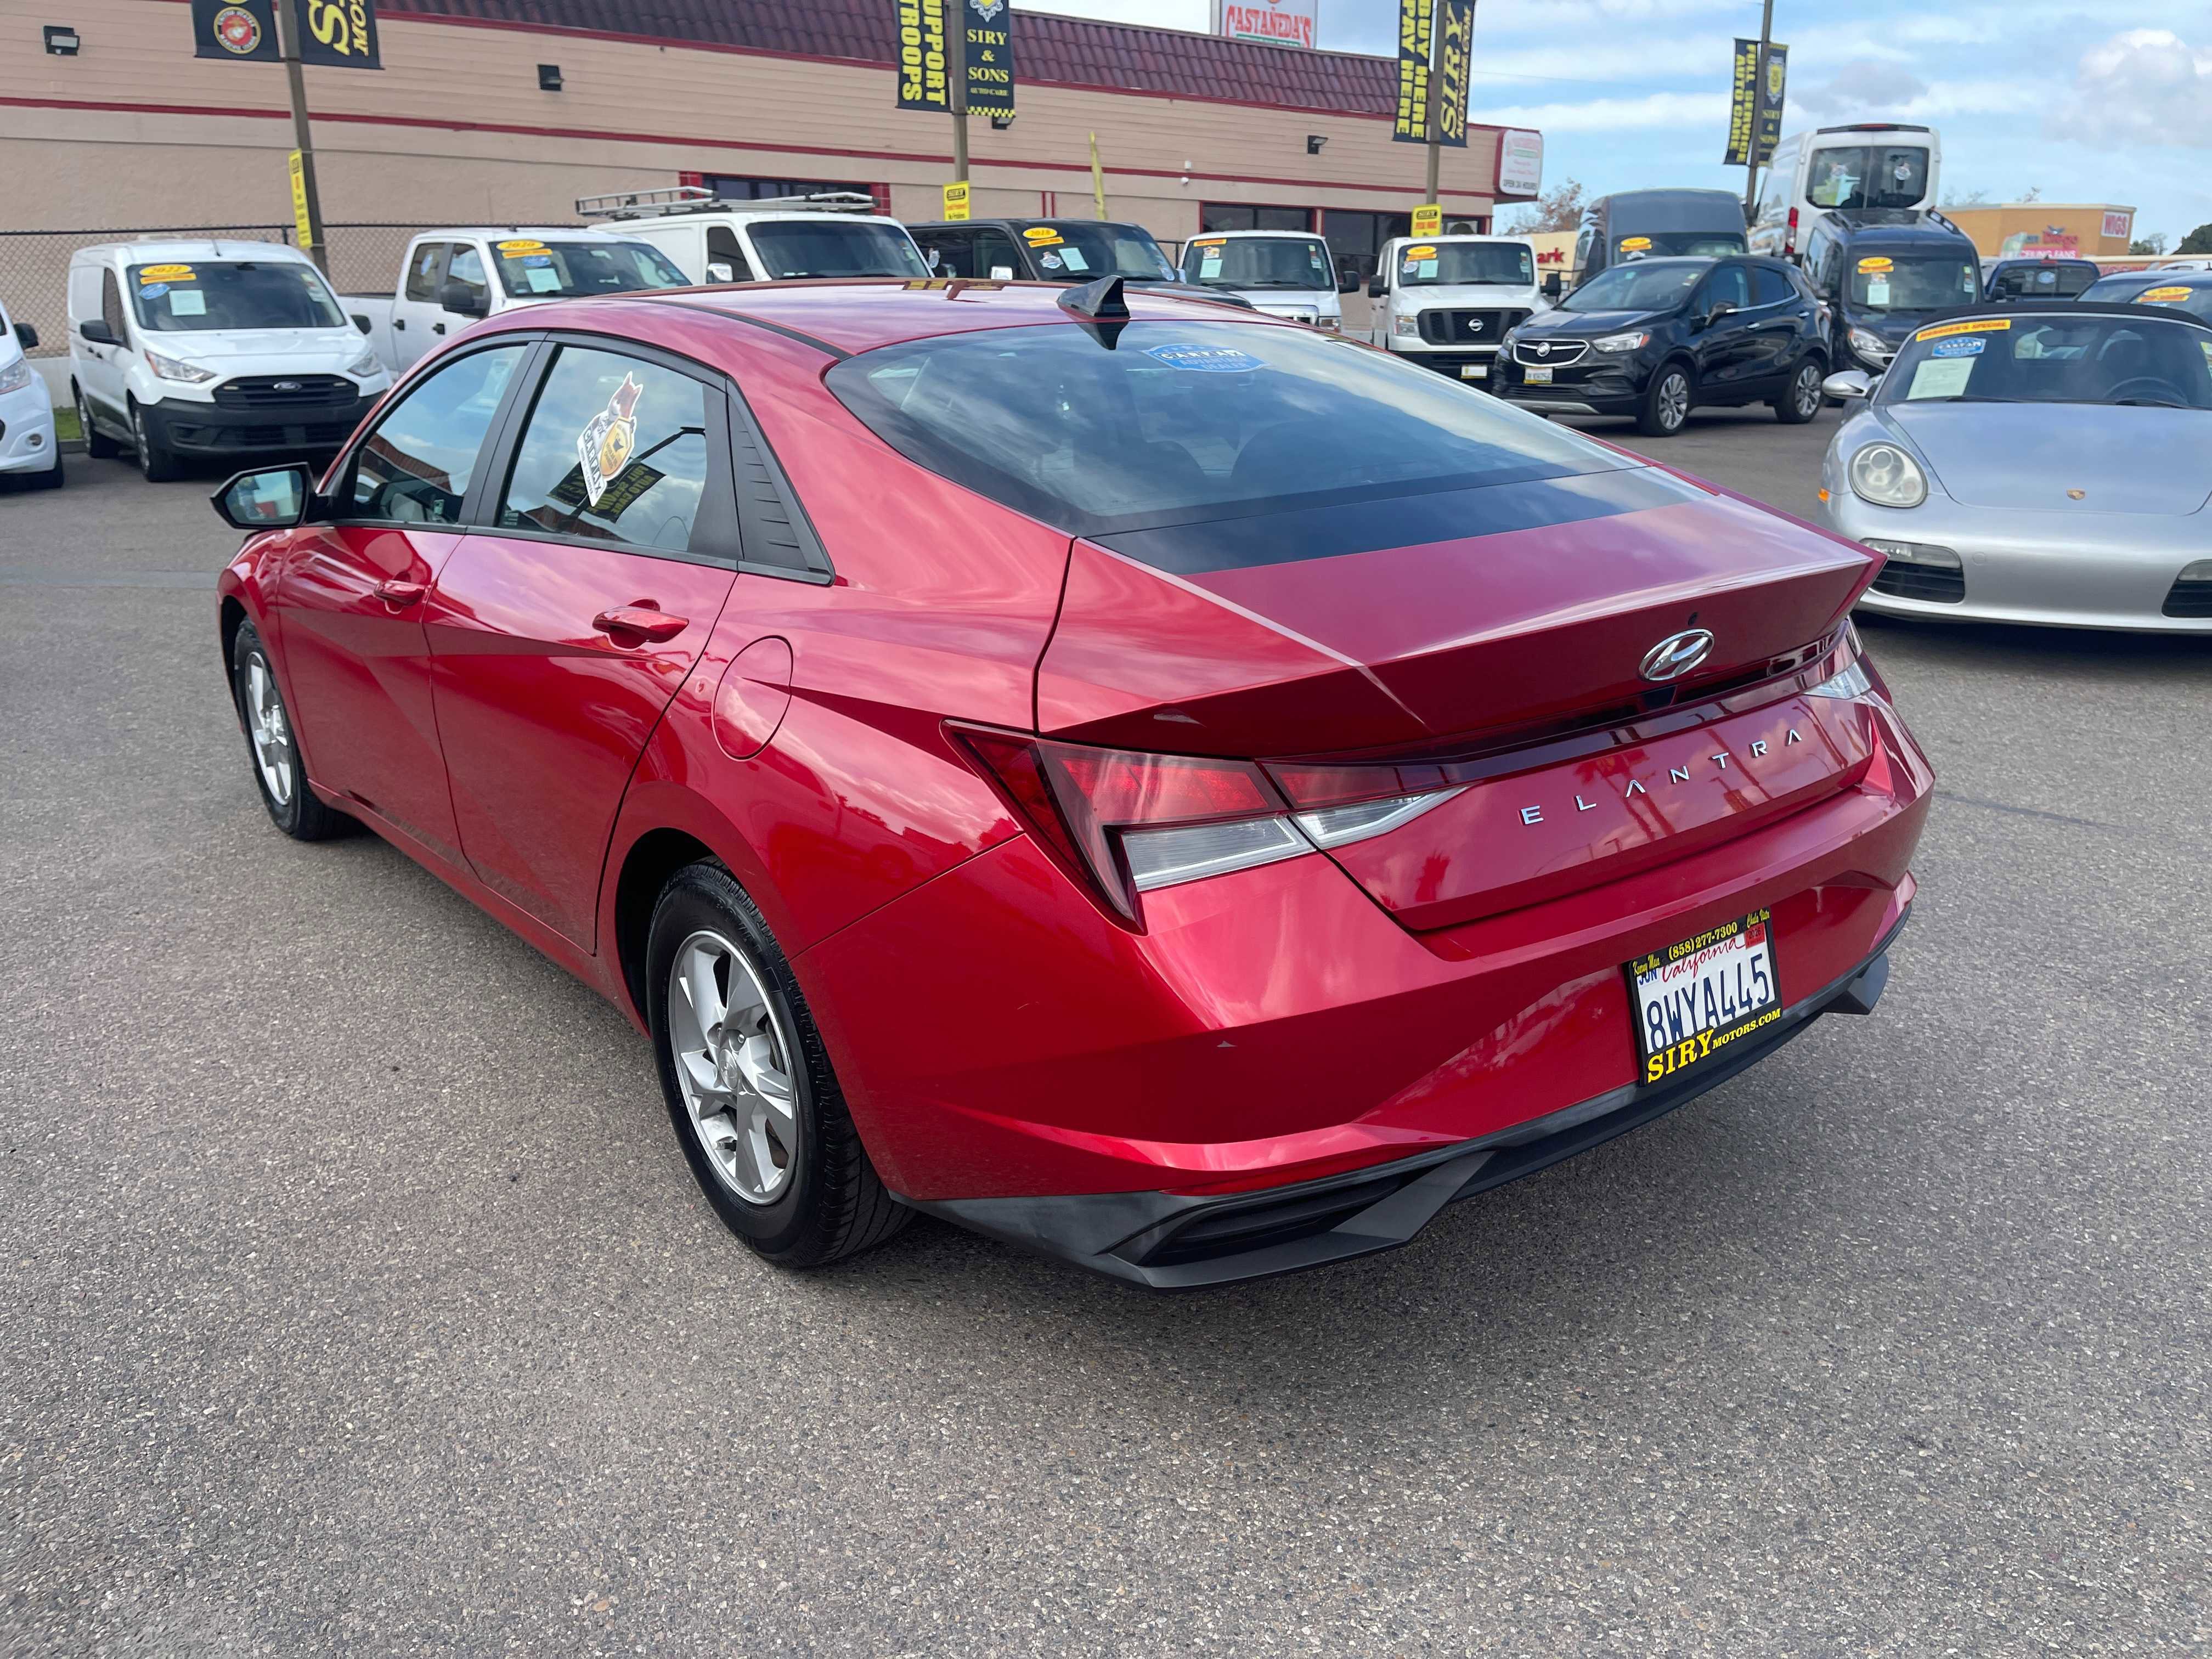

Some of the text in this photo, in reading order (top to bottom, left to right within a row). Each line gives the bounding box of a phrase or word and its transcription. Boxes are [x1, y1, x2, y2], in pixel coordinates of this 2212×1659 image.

[922, 0, 945, 105] UPPORT
[967, 29, 1007, 46] SIRY
[981, 49, 995, 62] &
[1396, 0, 1416, 134] PAY HERE
[1440, 2, 1463, 139] SIRY
[968, 66, 1009, 83] SONS
[1411, 65, 1427, 138] HERE
[2105, 215, 2128, 235] WIGS
[584, 429, 601, 494] CARFAX
[1521, 728, 1802, 825] ELANTRA
[1661, 937, 1746, 983] California
[1646, 953, 1770, 1051] 8WYA445
[1647, 1007, 1781, 1084] SIRY MOTORS.COM
